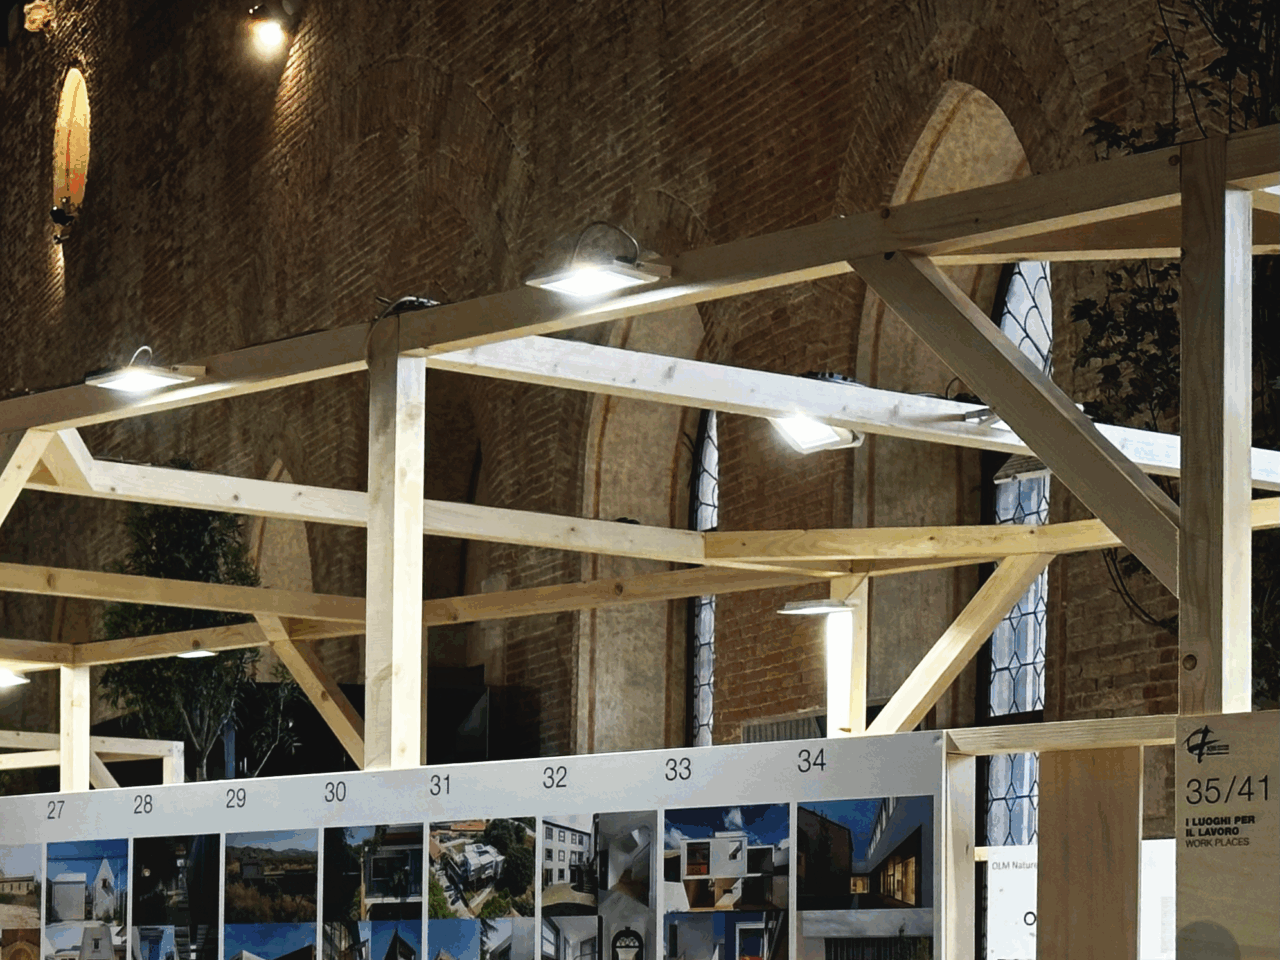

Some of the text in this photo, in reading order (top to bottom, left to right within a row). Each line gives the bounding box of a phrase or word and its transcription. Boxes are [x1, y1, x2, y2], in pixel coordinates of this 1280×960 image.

[665, 757, 692, 782] 33
[797, 747, 827, 773] 34
[429, 774, 450, 796] 31
[542, 765, 568, 789] 32
[226, 787, 247, 809] 29
[324, 780, 347, 803] 30
[1185, 774, 1269, 805] 35/41
[46, 800, 65, 820] 27
[133, 794, 153, 815] 28
[1185, 815, 1255, 826] I LUOGHI PER
[1185, 827, 1239, 837] IL LAVORO
[1185, 837, 1250, 848] WORK PLACES
[992, 861, 1010, 870] OLM
